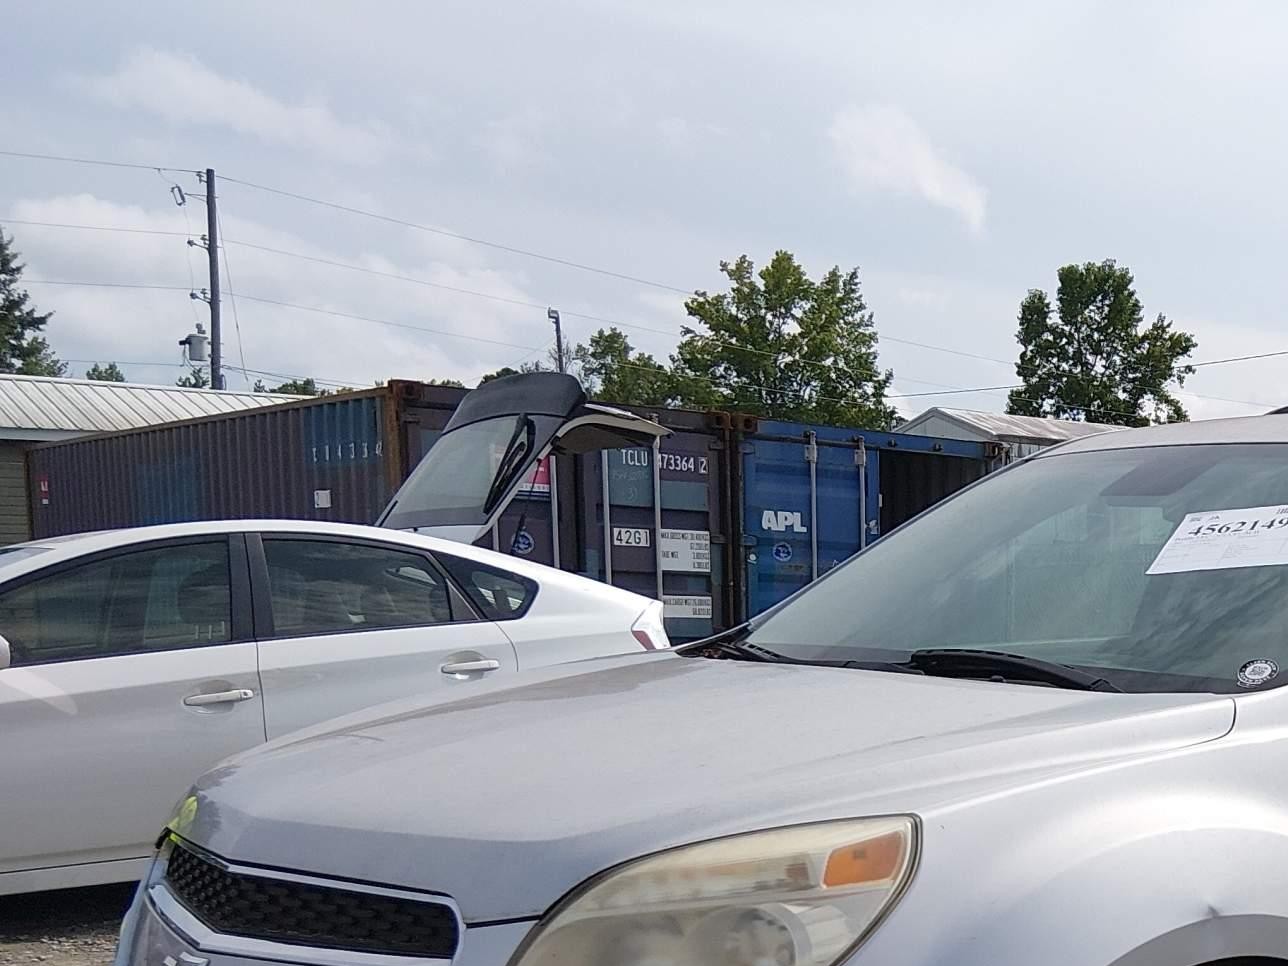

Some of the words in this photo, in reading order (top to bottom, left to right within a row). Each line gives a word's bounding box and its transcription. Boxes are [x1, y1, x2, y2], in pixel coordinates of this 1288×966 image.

[621, 449, 648, 466] TCLU
[699, 457, 707, 473] 2
[761, 510, 807, 533] APL
[615, 530, 649, 545] 42G1
